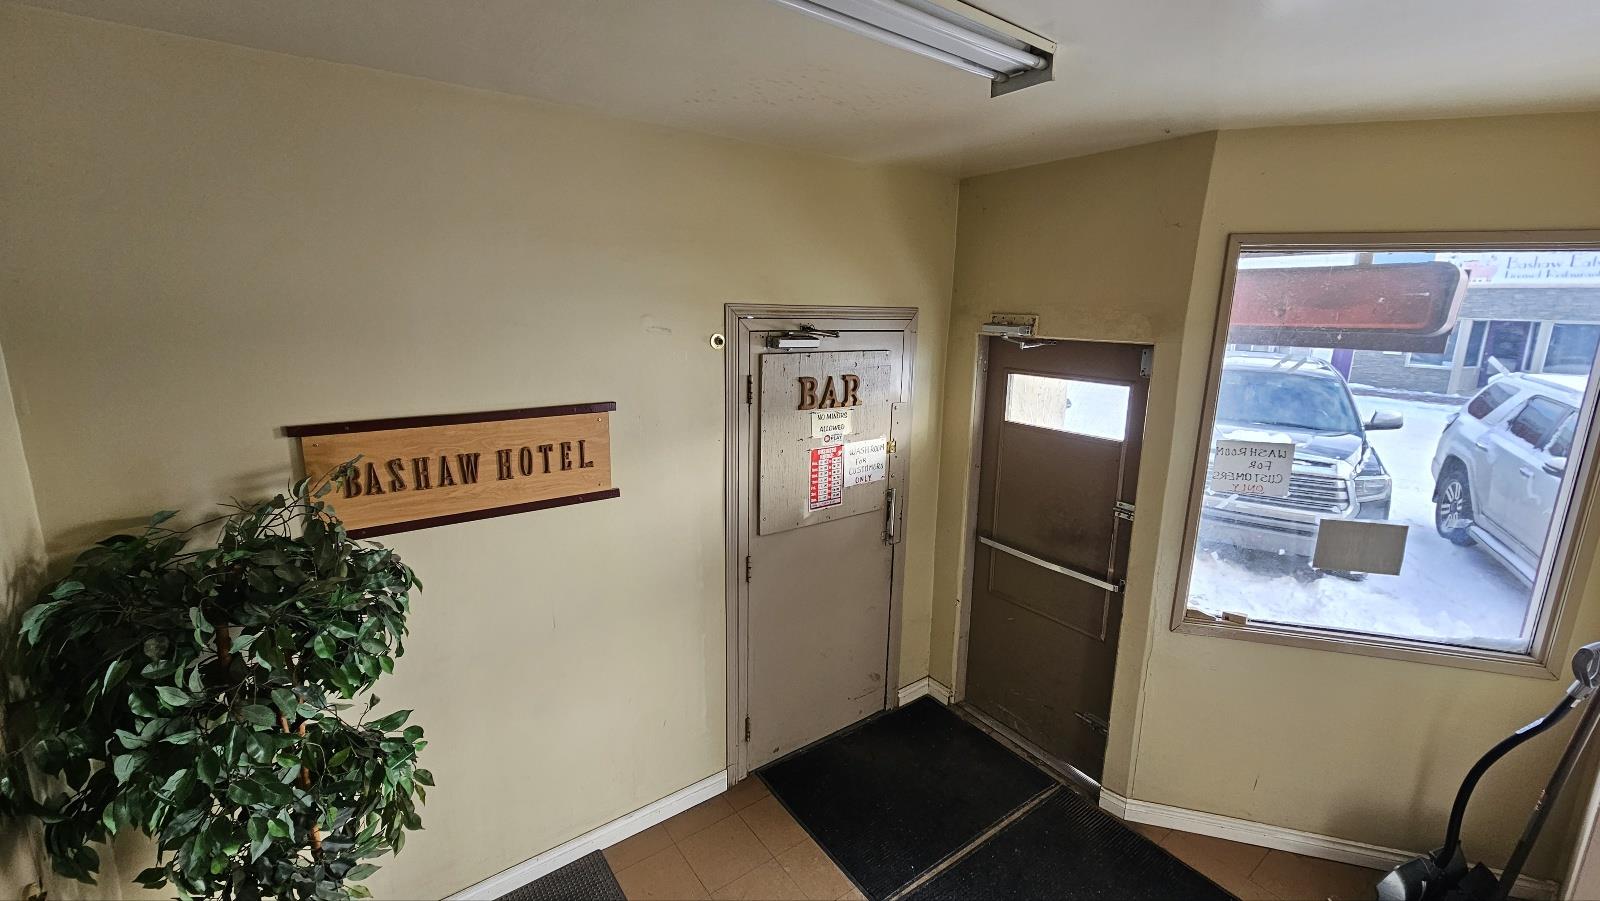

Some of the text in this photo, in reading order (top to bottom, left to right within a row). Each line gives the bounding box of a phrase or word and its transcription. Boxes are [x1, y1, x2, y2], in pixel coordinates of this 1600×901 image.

[797, 374, 863, 411] BAR
[817, 411, 848, 421] NO MINORS
[819, 423, 846, 433] ALLOWED
[343, 439, 594, 499] BASHAW HOTEL
[855, 473, 873, 484] ONLY
